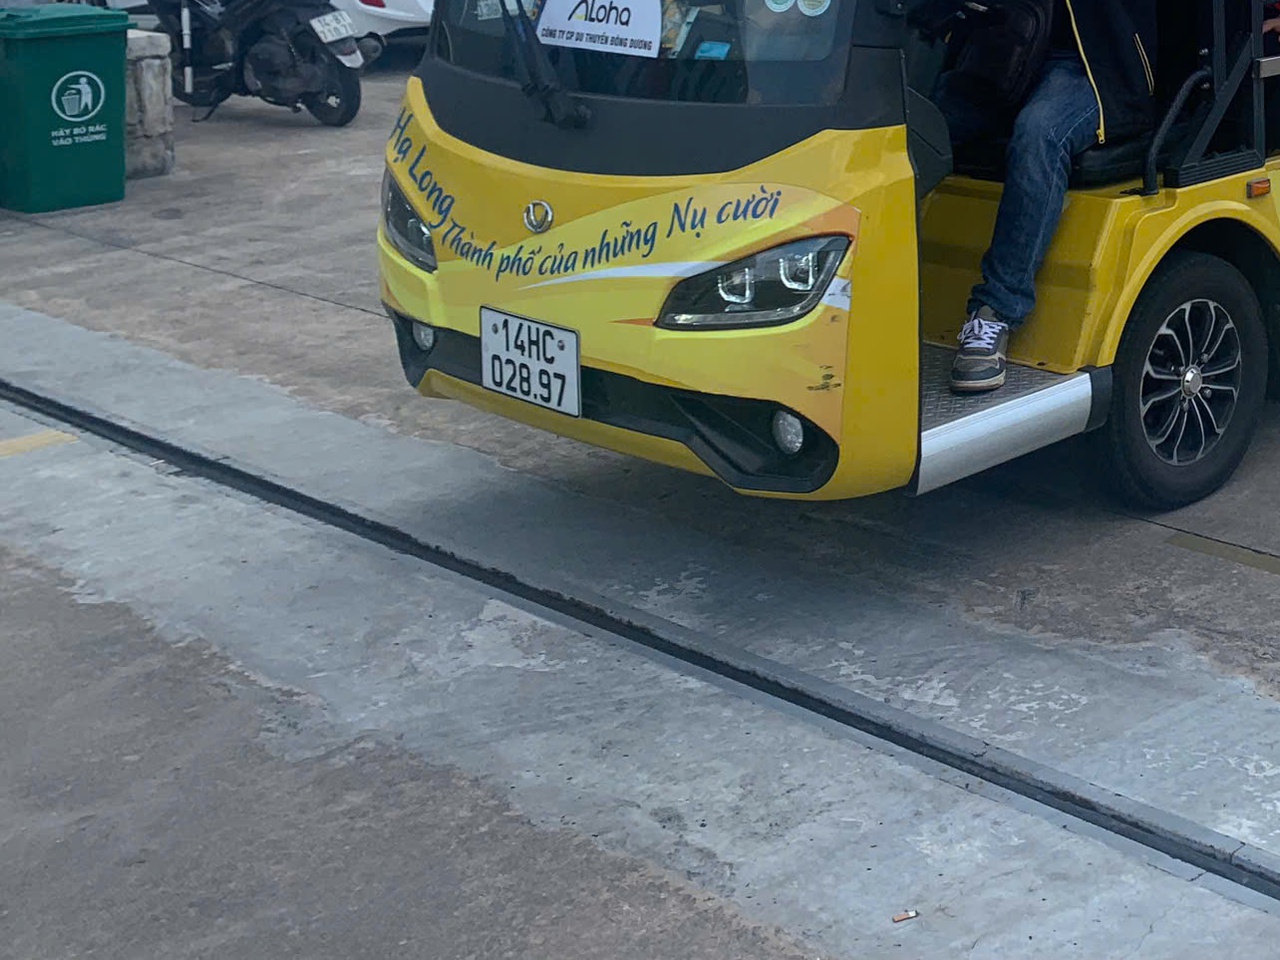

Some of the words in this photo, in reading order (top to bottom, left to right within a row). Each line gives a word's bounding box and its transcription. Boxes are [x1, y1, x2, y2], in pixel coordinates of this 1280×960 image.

[389, 109, 413, 165] Hạ
[408, 147, 455, 229] Long
[441, 217, 495, 269] Thành
[495, 243, 541, 282] phố
[537, 241, 579, 276] của
[583, 220, 659, 269] những
[666, 196, 707, 239] Nụ
[715, 184, 783, 225] cười
[501, 317, 556, 365] 14HC
[491, 354, 566, 408] 028.97
